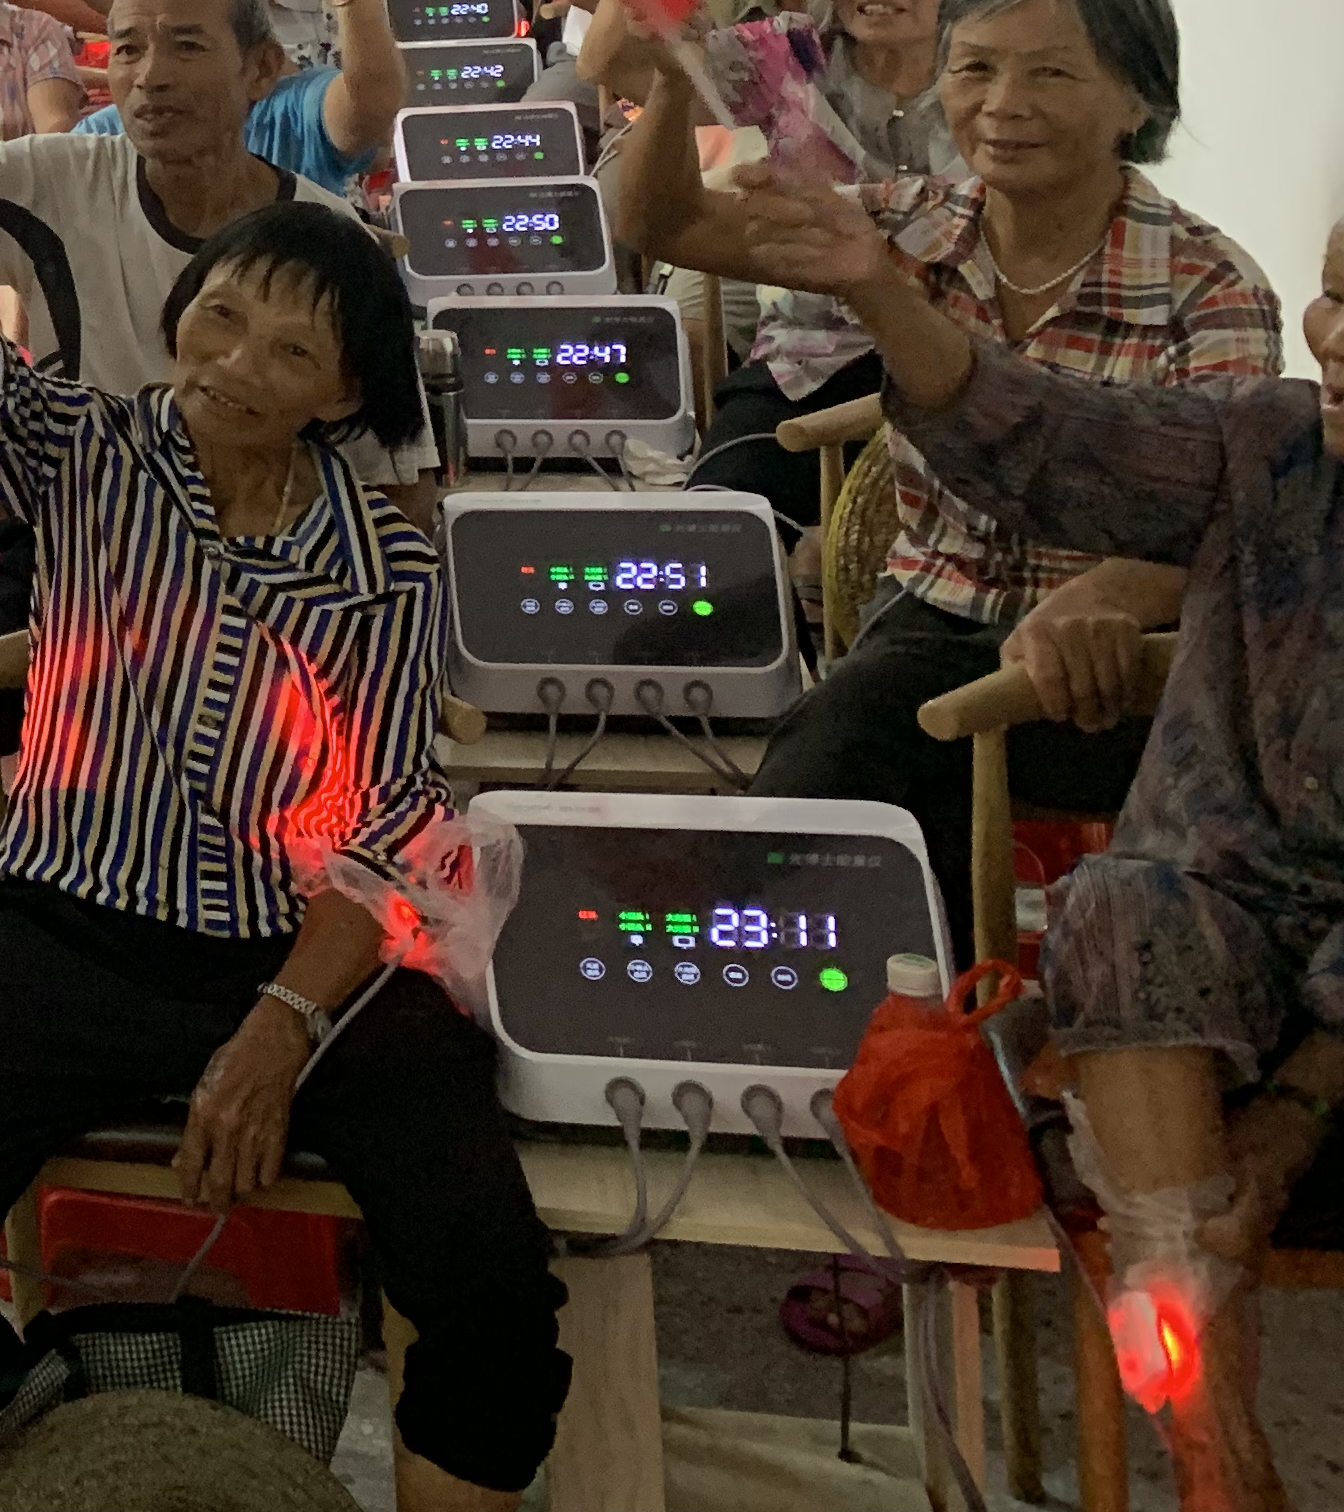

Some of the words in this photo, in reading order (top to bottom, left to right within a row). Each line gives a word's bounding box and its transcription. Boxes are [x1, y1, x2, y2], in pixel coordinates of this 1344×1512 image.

[461, 64, 504, 79] 22:42
[491, 134, 541, 150] 22:44
[502, 213, 560, 232] 22:50
[556, 343, 627, 366] 22:47
[615, 561, 708, 591] 22:51
[709, 906, 838, 949] 23:11
